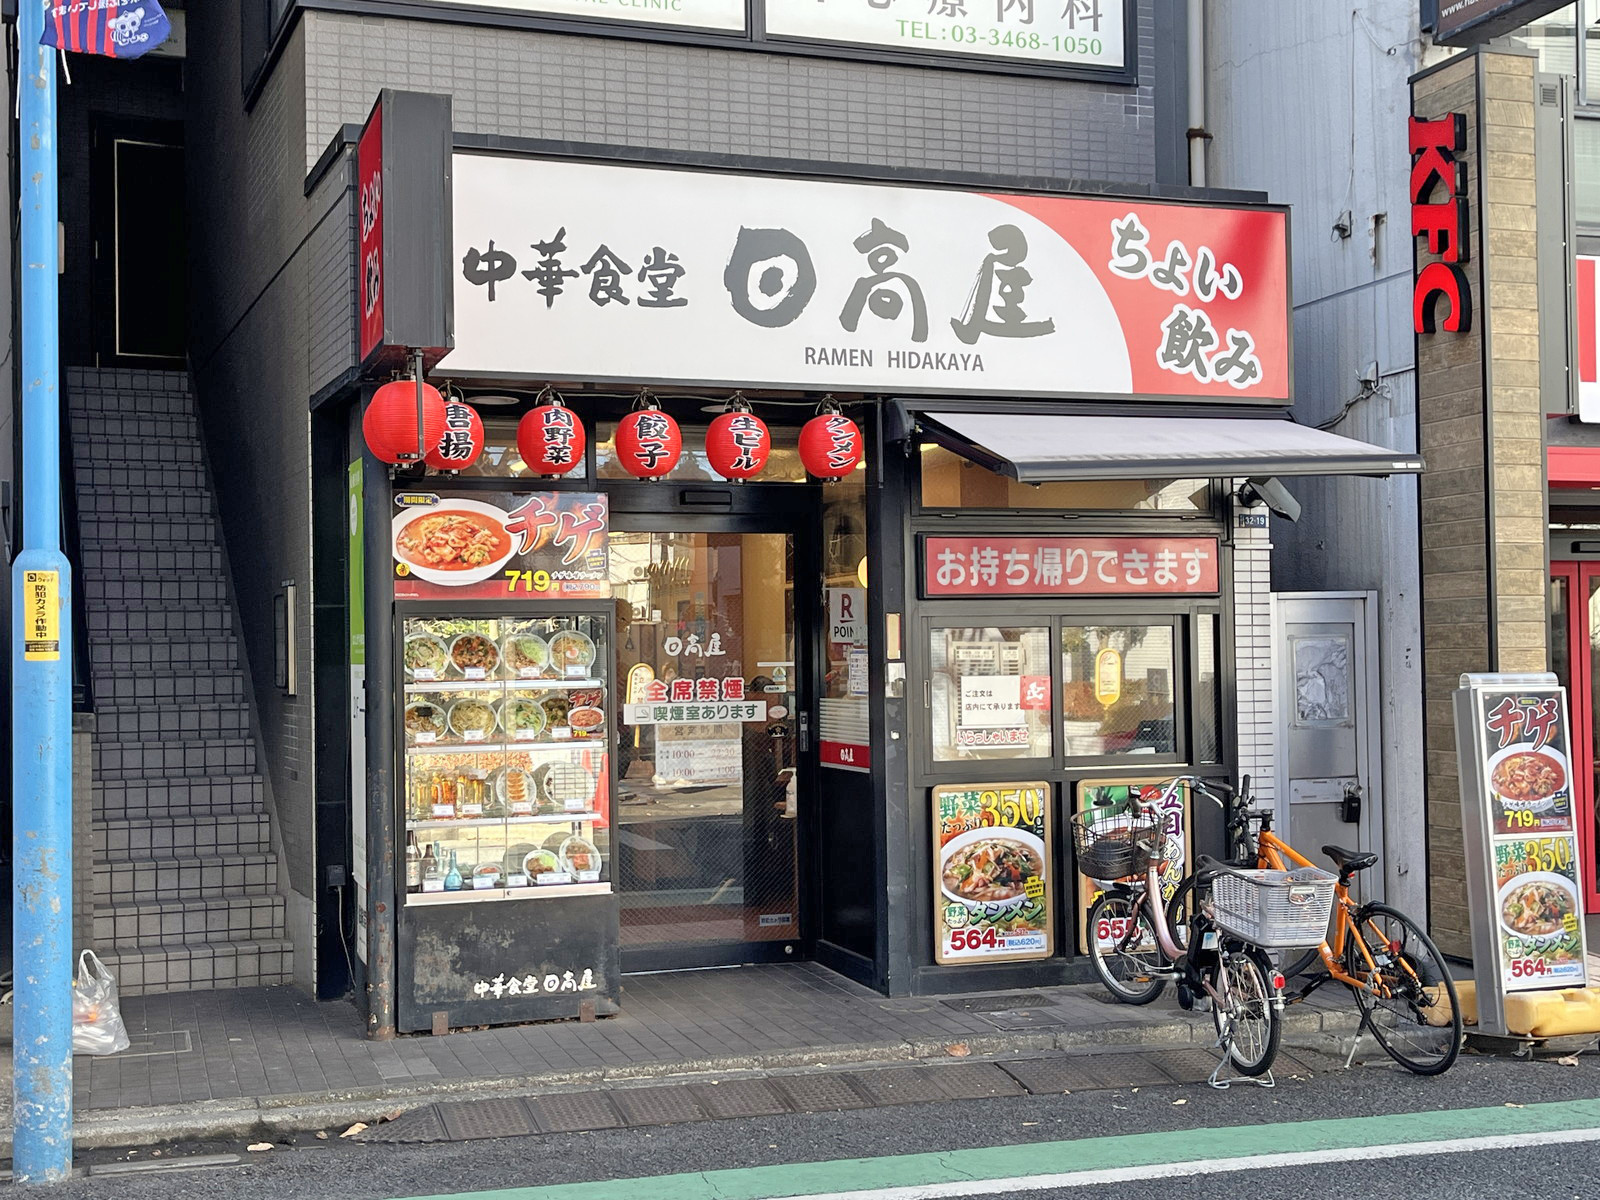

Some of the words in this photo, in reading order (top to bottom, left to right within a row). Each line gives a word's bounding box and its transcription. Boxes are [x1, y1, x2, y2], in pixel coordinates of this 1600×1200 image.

[895, 19, 1102, 56] TEL:03-3468-1050
[1409, 113, 1471, 333] KFC
[1109, 215, 1242, 302] ちょい
[463, 227, 688, 309] 中華食堂
[724, 217, 1054, 345] 日高屋
[805, 347, 874, 367] RAMEN
[887, 351, 985, 373] HIDAKAYA
[1158, 307, 1262, 388] 飲み
[439, 404, 474, 460] 唐揚
[543, 408, 575, 465] 肉野菜
[634, 414, 671, 469] 餃子
[728, 416, 764, 471] 生ビール
[825, 416, 857, 469] タンメン
[504, 497, 606, 566] チゲ
[936, 546, 1209, 586] お持ち帰りできます
[840, 593, 854, 619] R
[664, 632, 726, 657] 日高屋
[646, 677, 745, 702] 全席禁煙
[653, 704, 758, 722] 喫煙室あります
[1487, 697, 1558, 750] チゲ
[957, 729, 1029, 744] いらっしゃいませ
[940, 792, 981, 820] 野菜
[969, 901, 1044, 926] タンメン
[1524, 934, 1578, 956] タンメン
[474, 973, 539, 999] 中華食堂
[543, 968, 597, 992] 日高屋
